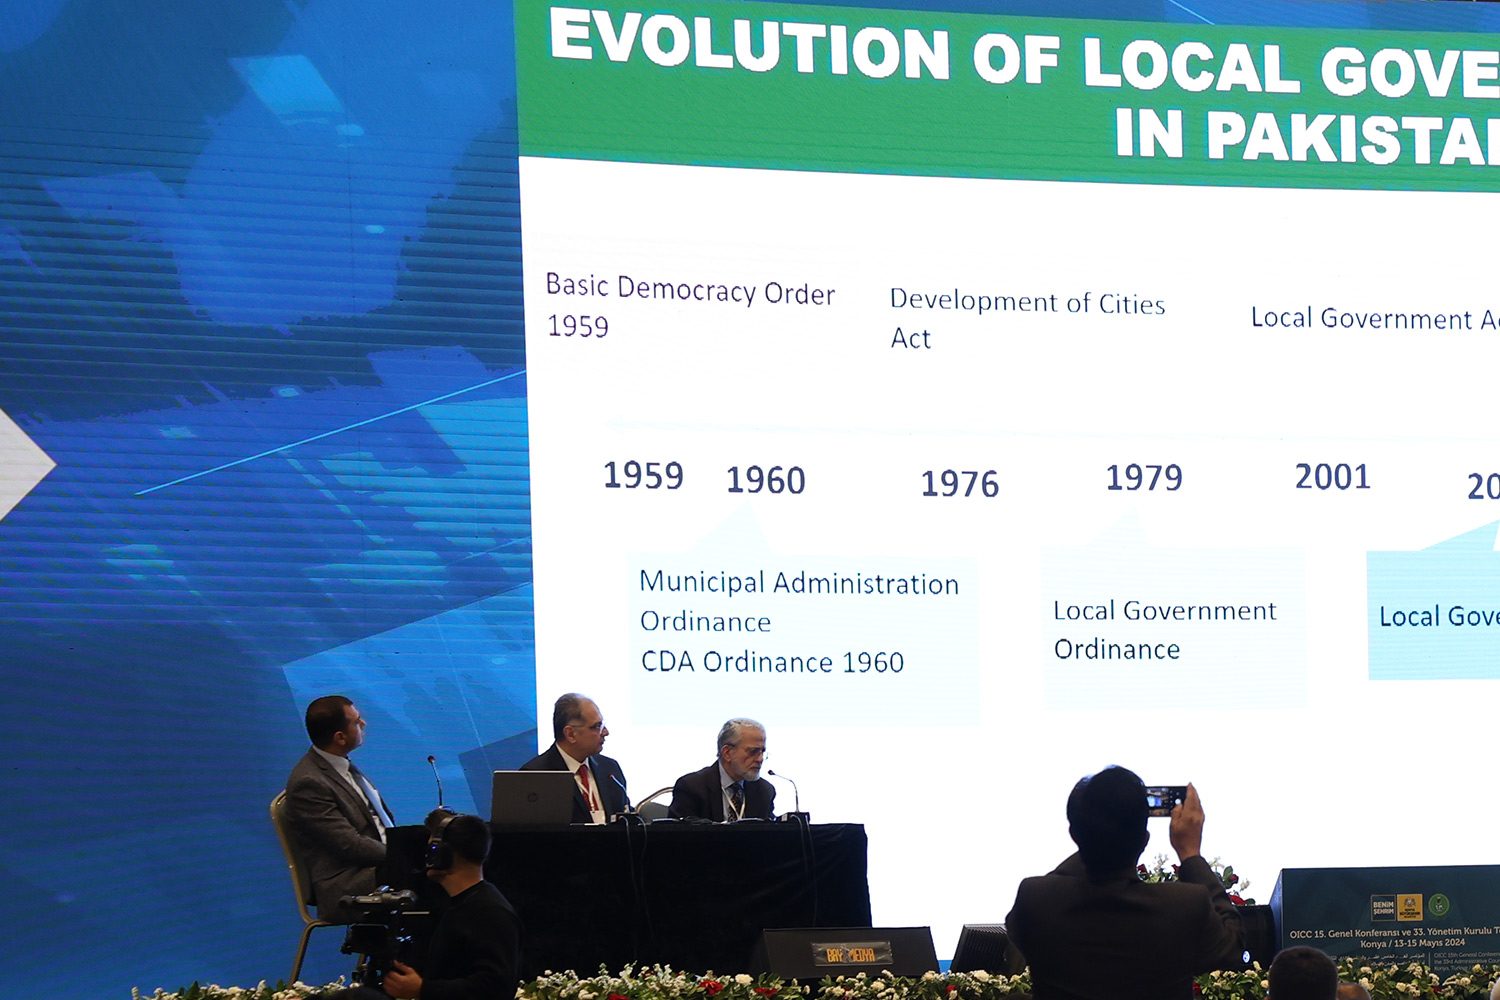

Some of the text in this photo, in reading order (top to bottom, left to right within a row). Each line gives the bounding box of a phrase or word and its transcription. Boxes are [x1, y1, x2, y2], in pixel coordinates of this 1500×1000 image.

[550, 7, 950, 80] EVOLUTION
[974, 33, 1060, 84] OF
[1085, 38, 1300, 93] LOCAL
[1117, 108, 1182, 158] IN
[547, 272, 836, 307] Basic Democracy Order
[892, 288, 1165, 316] Development of Cities
[549, 315, 608, 339] 1959
[1253, 306, 1312, 328] Local
[1322, 308, 1473, 330] Government
[891, 327, 931, 350] Act
[605, 460, 683, 489] 1959
[728, 465, 805, 494] 1960
[923, 469, 999, 498] 1976
[1108, 463, 1182, 491] 1979
[1296, 463, 1370, 490] 2001
[641, 570, 959, 597] Municipal Administration
[641, 610, 771, 633] Ordinance
[1055, 599, 1277, 621] Local Government
[1381, 604, 1440, 627] Local
[1055, 637, 1180, 660] Ordinance
[642, 650, 904, 674] CDA Ordinance 1960
[1290, 930, 1313, 939] OICC
[1315, 930, 1326, 938] 15.
[1328, 929, 1353, 938] Genel
[1355, 928, 1400, 938] Konferansı
[1413, 928, 1425, 936] 33.
[1427, 926, 1462, 936] Yönetim
[1464, 926, 1492, 935] Kurulu
[1360, 940, 1387, 950] Konya
[1394, 939, 1417, 948] 13-15
[1419, 939, 1443, 949] Mayıs
[1445, 938, 1466, 947] 2024
[826, 948, 876, 963] BAY MEDYA
